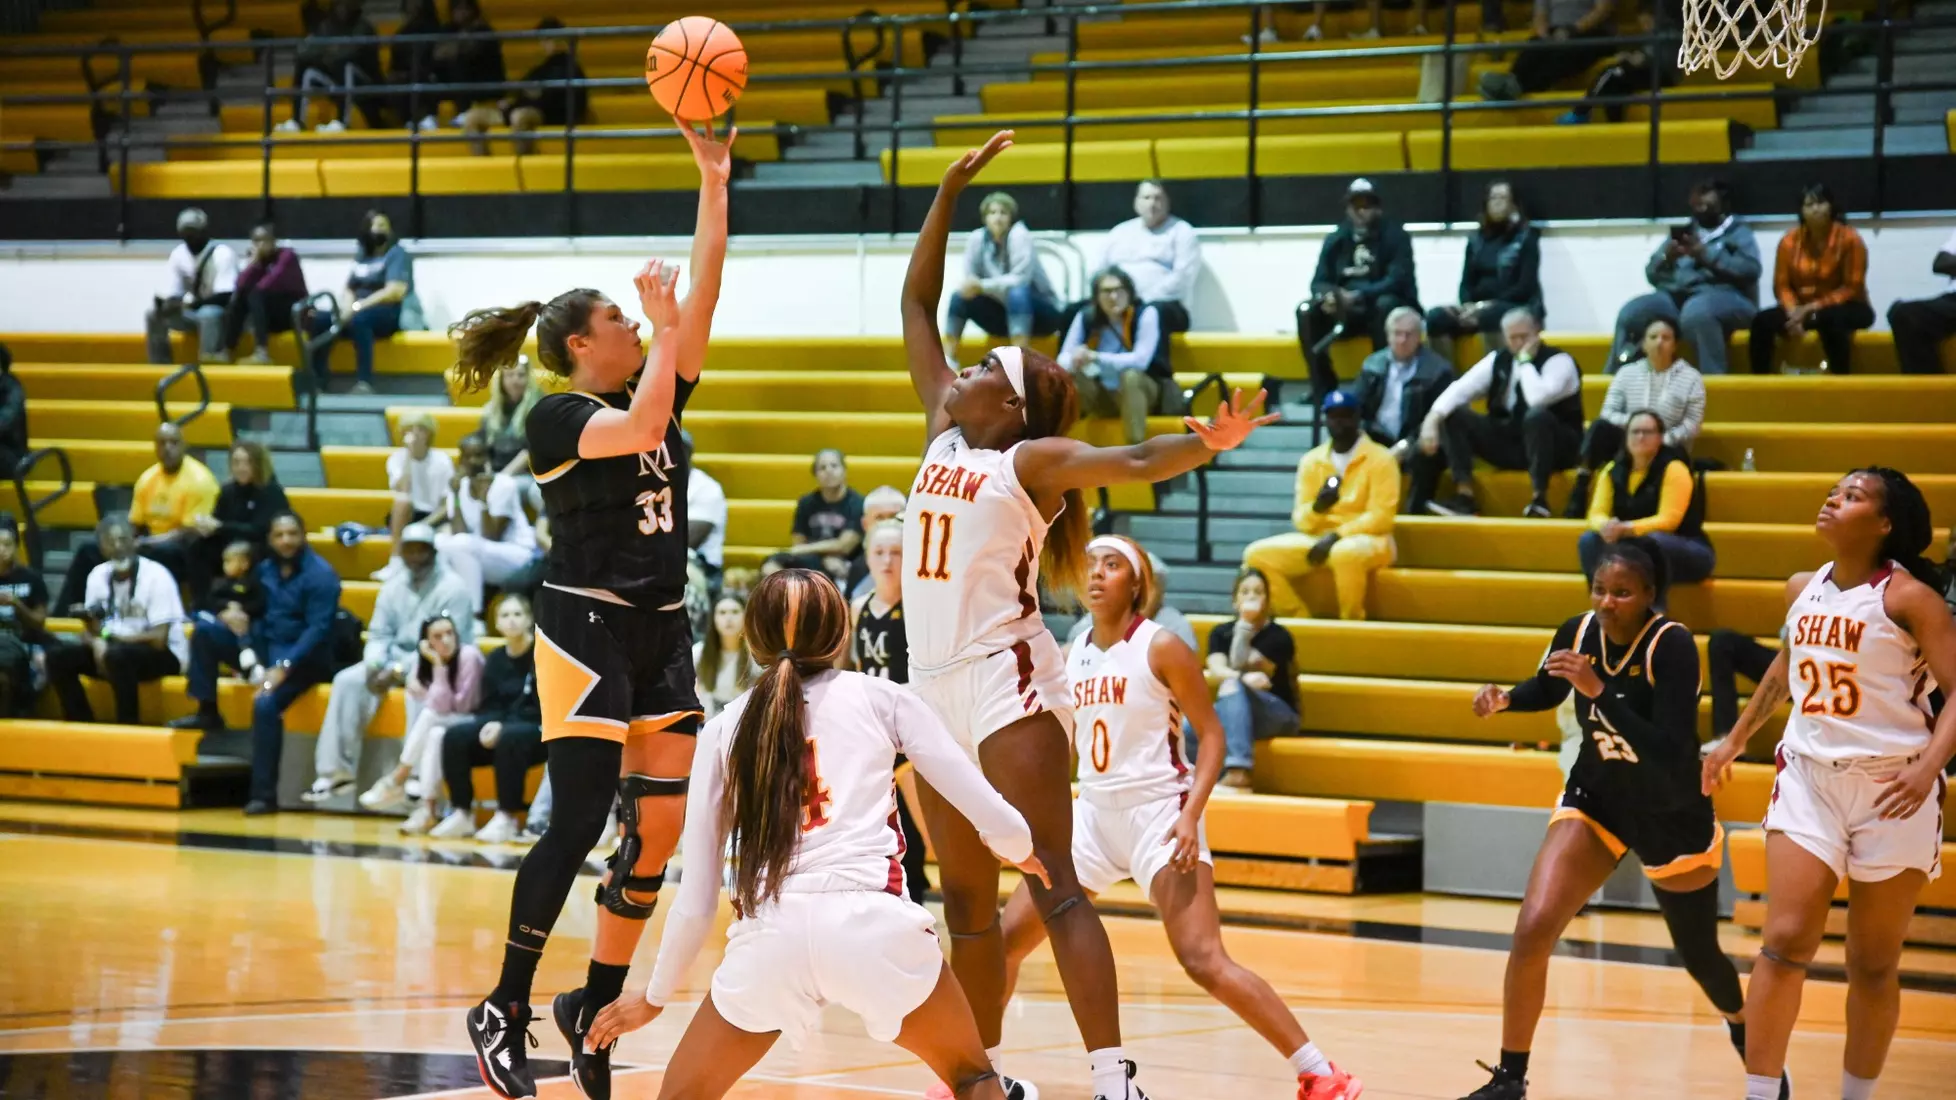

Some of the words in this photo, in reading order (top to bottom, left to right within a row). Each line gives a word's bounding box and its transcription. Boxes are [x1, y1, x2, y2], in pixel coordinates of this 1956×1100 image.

[916, 463, 989, 504] SHAW
[633, 486, 674, 536] 33
[916, 509, 956, 582] 11
[1794, 614, 1868, 654] SHAW
[1074, 676, 1127, 710] SHAW
[1798, 656, 1863, 718] 25
[1091, 718, 1111, 774] 0
[1592, 730, 1640, 764] 23
